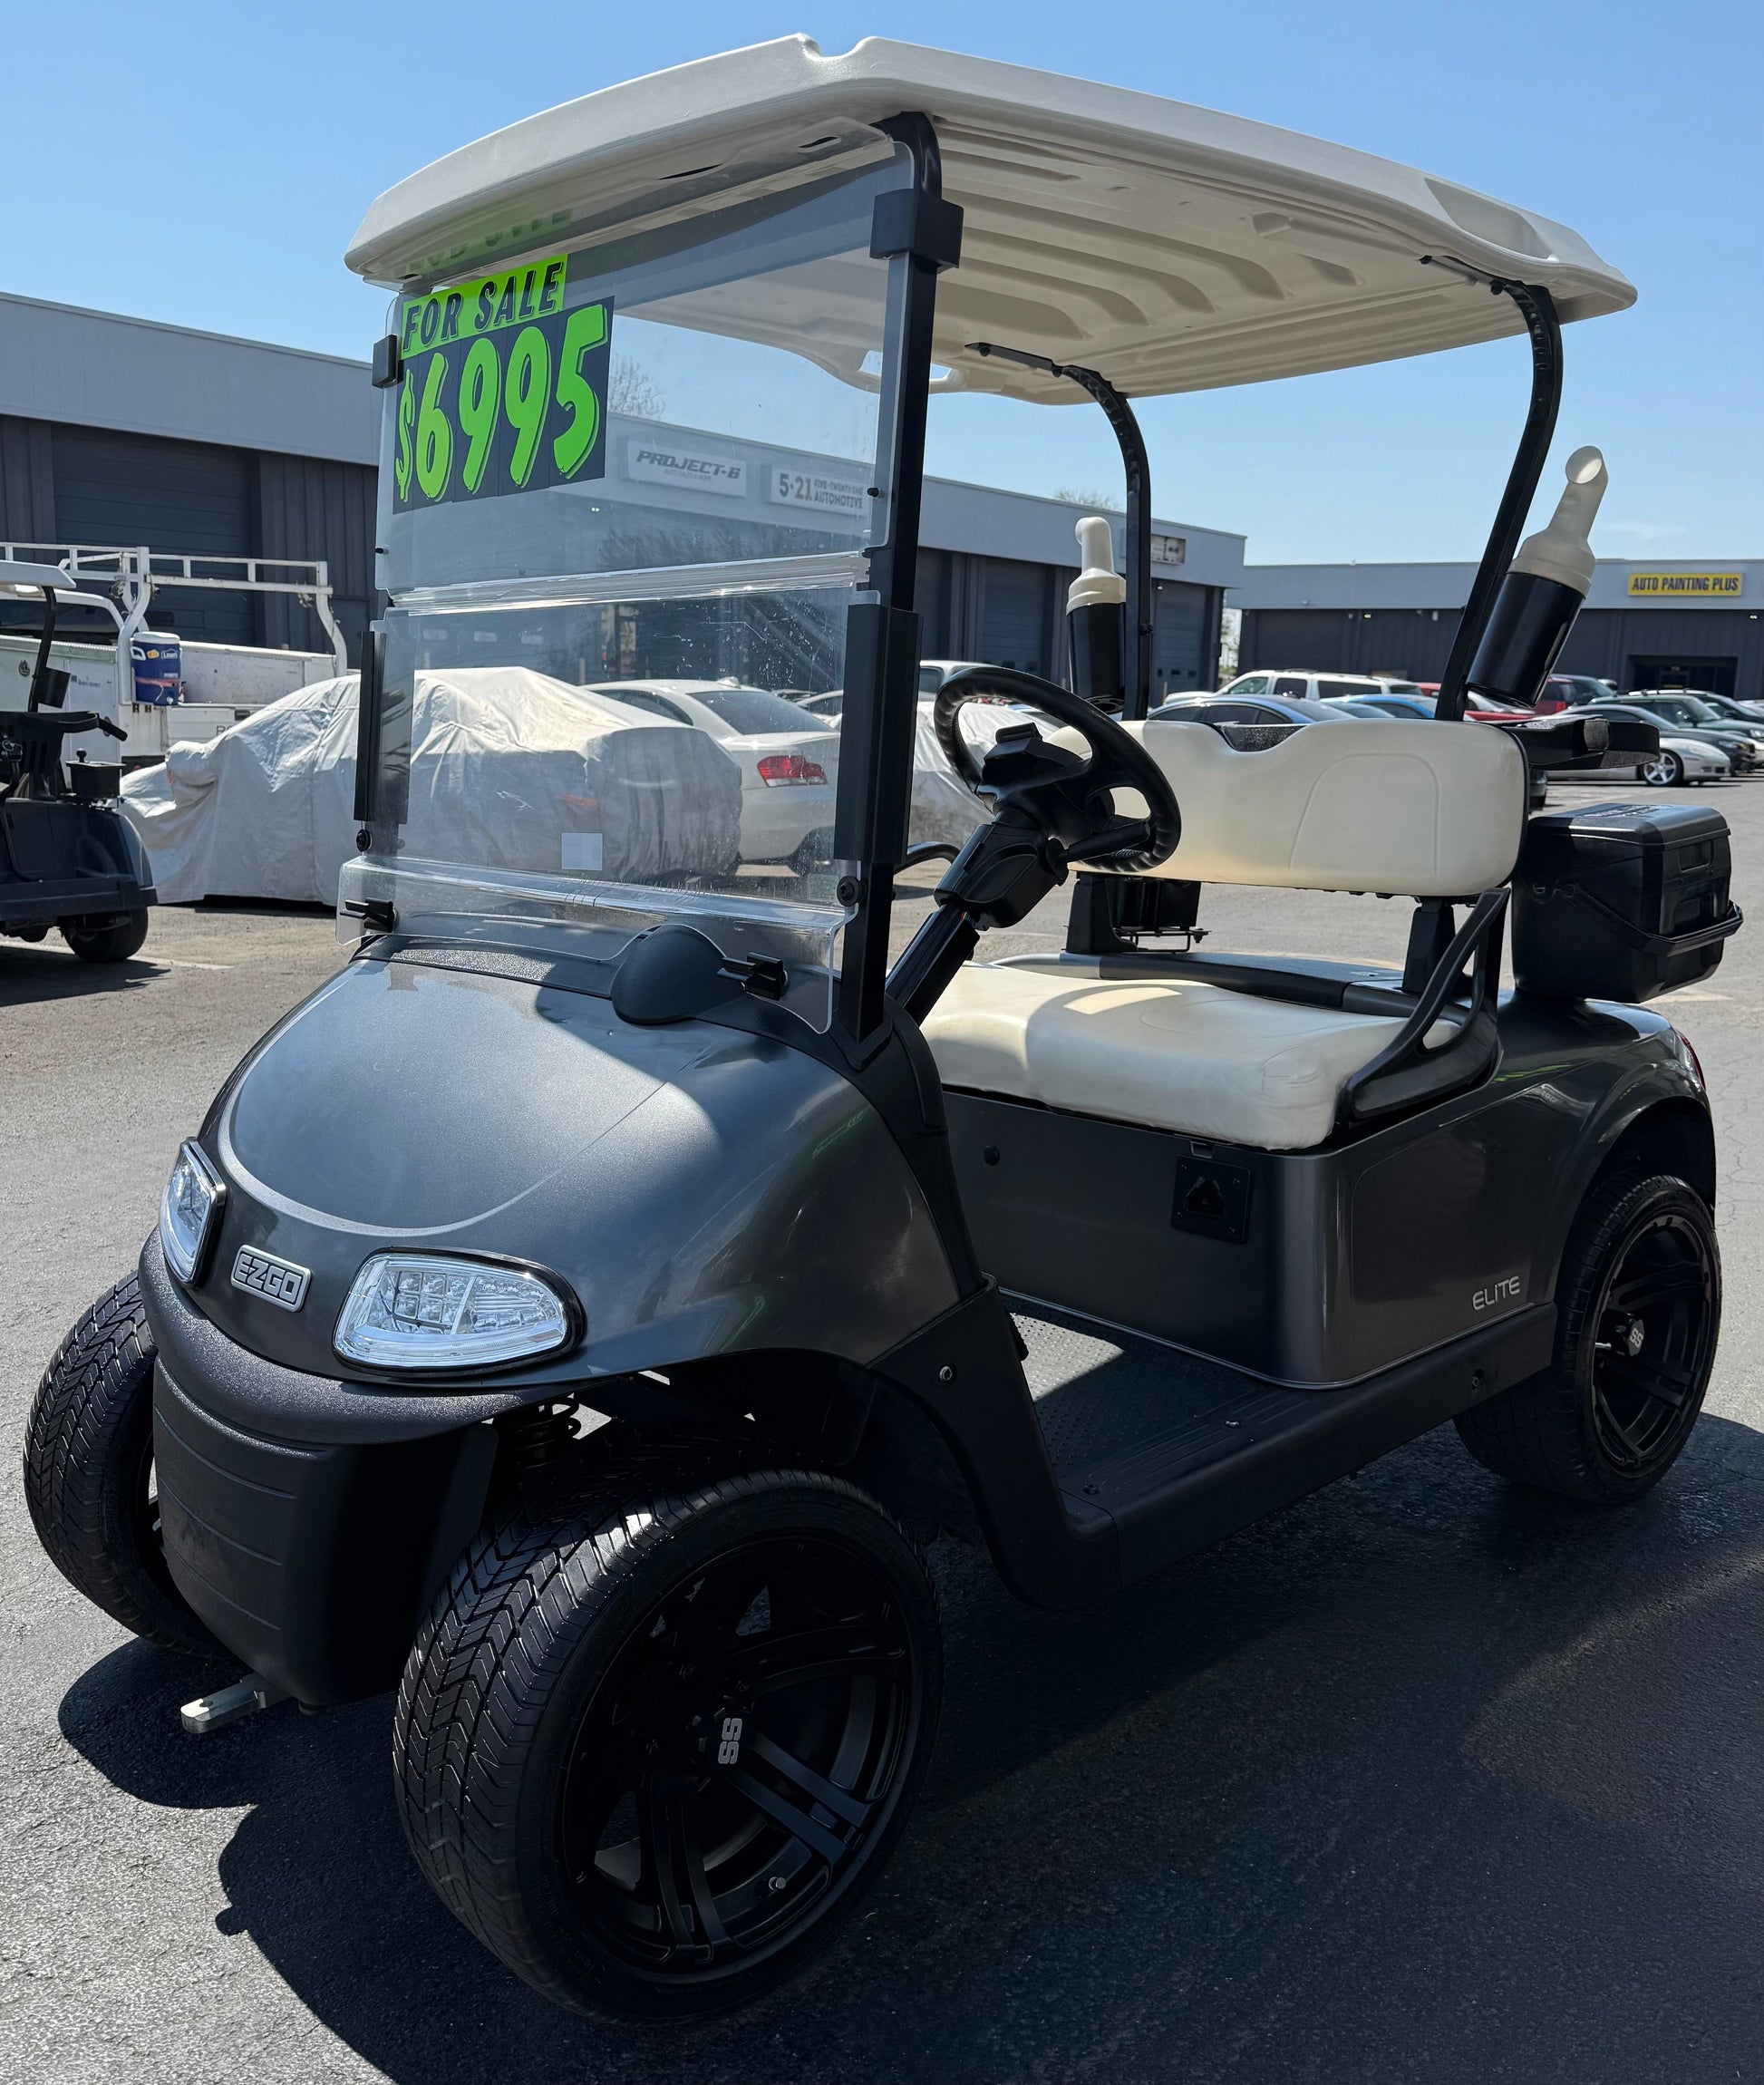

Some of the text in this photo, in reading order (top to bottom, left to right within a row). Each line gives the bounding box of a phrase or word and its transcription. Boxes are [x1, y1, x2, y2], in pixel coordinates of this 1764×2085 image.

[402, 260, 564, 352] FOR SALE
[395, 304, 608, 502] $6995
[635, 450, 741, 480] PROJECT-B
[814, 490, 863, 509] AUTOMOTIVE
[1633, 577, 1740, 591] AUTO PAINTING PLUS
[234, 1252, 304, 1304] EZGO
[1629, 1327, 1644, 1349] SS
[717, 1717, 743, 1765] SS
